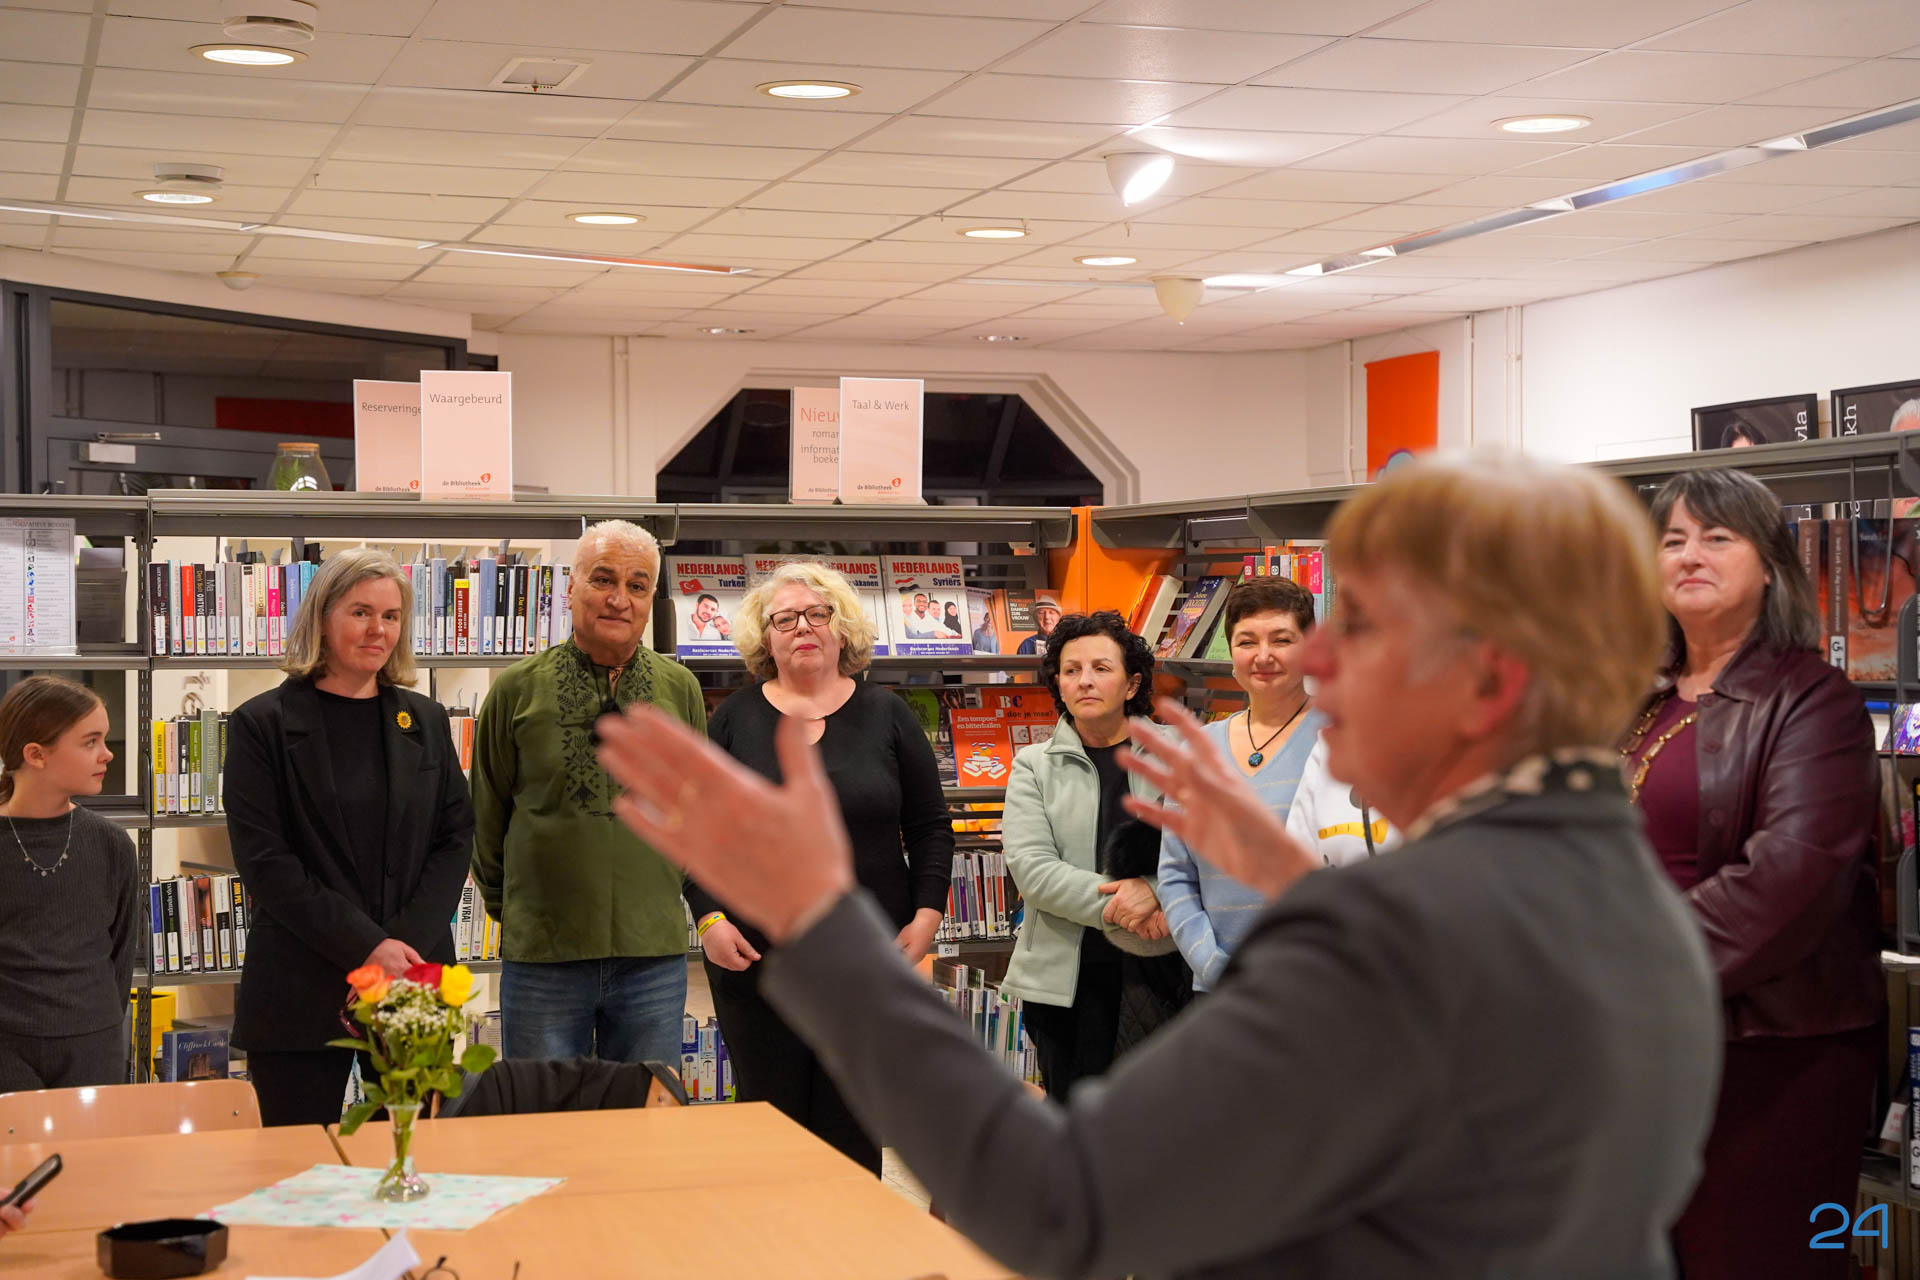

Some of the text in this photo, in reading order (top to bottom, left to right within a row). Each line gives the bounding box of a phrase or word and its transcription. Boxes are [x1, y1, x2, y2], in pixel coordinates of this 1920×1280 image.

[429, 393, 502, 406] Waargebeurd
[852, 399, 910, 411] Taal & Werk
[677, 563, 745, 575] NEDERLANDS
[892, 562, 960, 574] NEDERLANDS
[207, 716, 216, 745] Menno
[463, 887, 473, 904] RUDI
